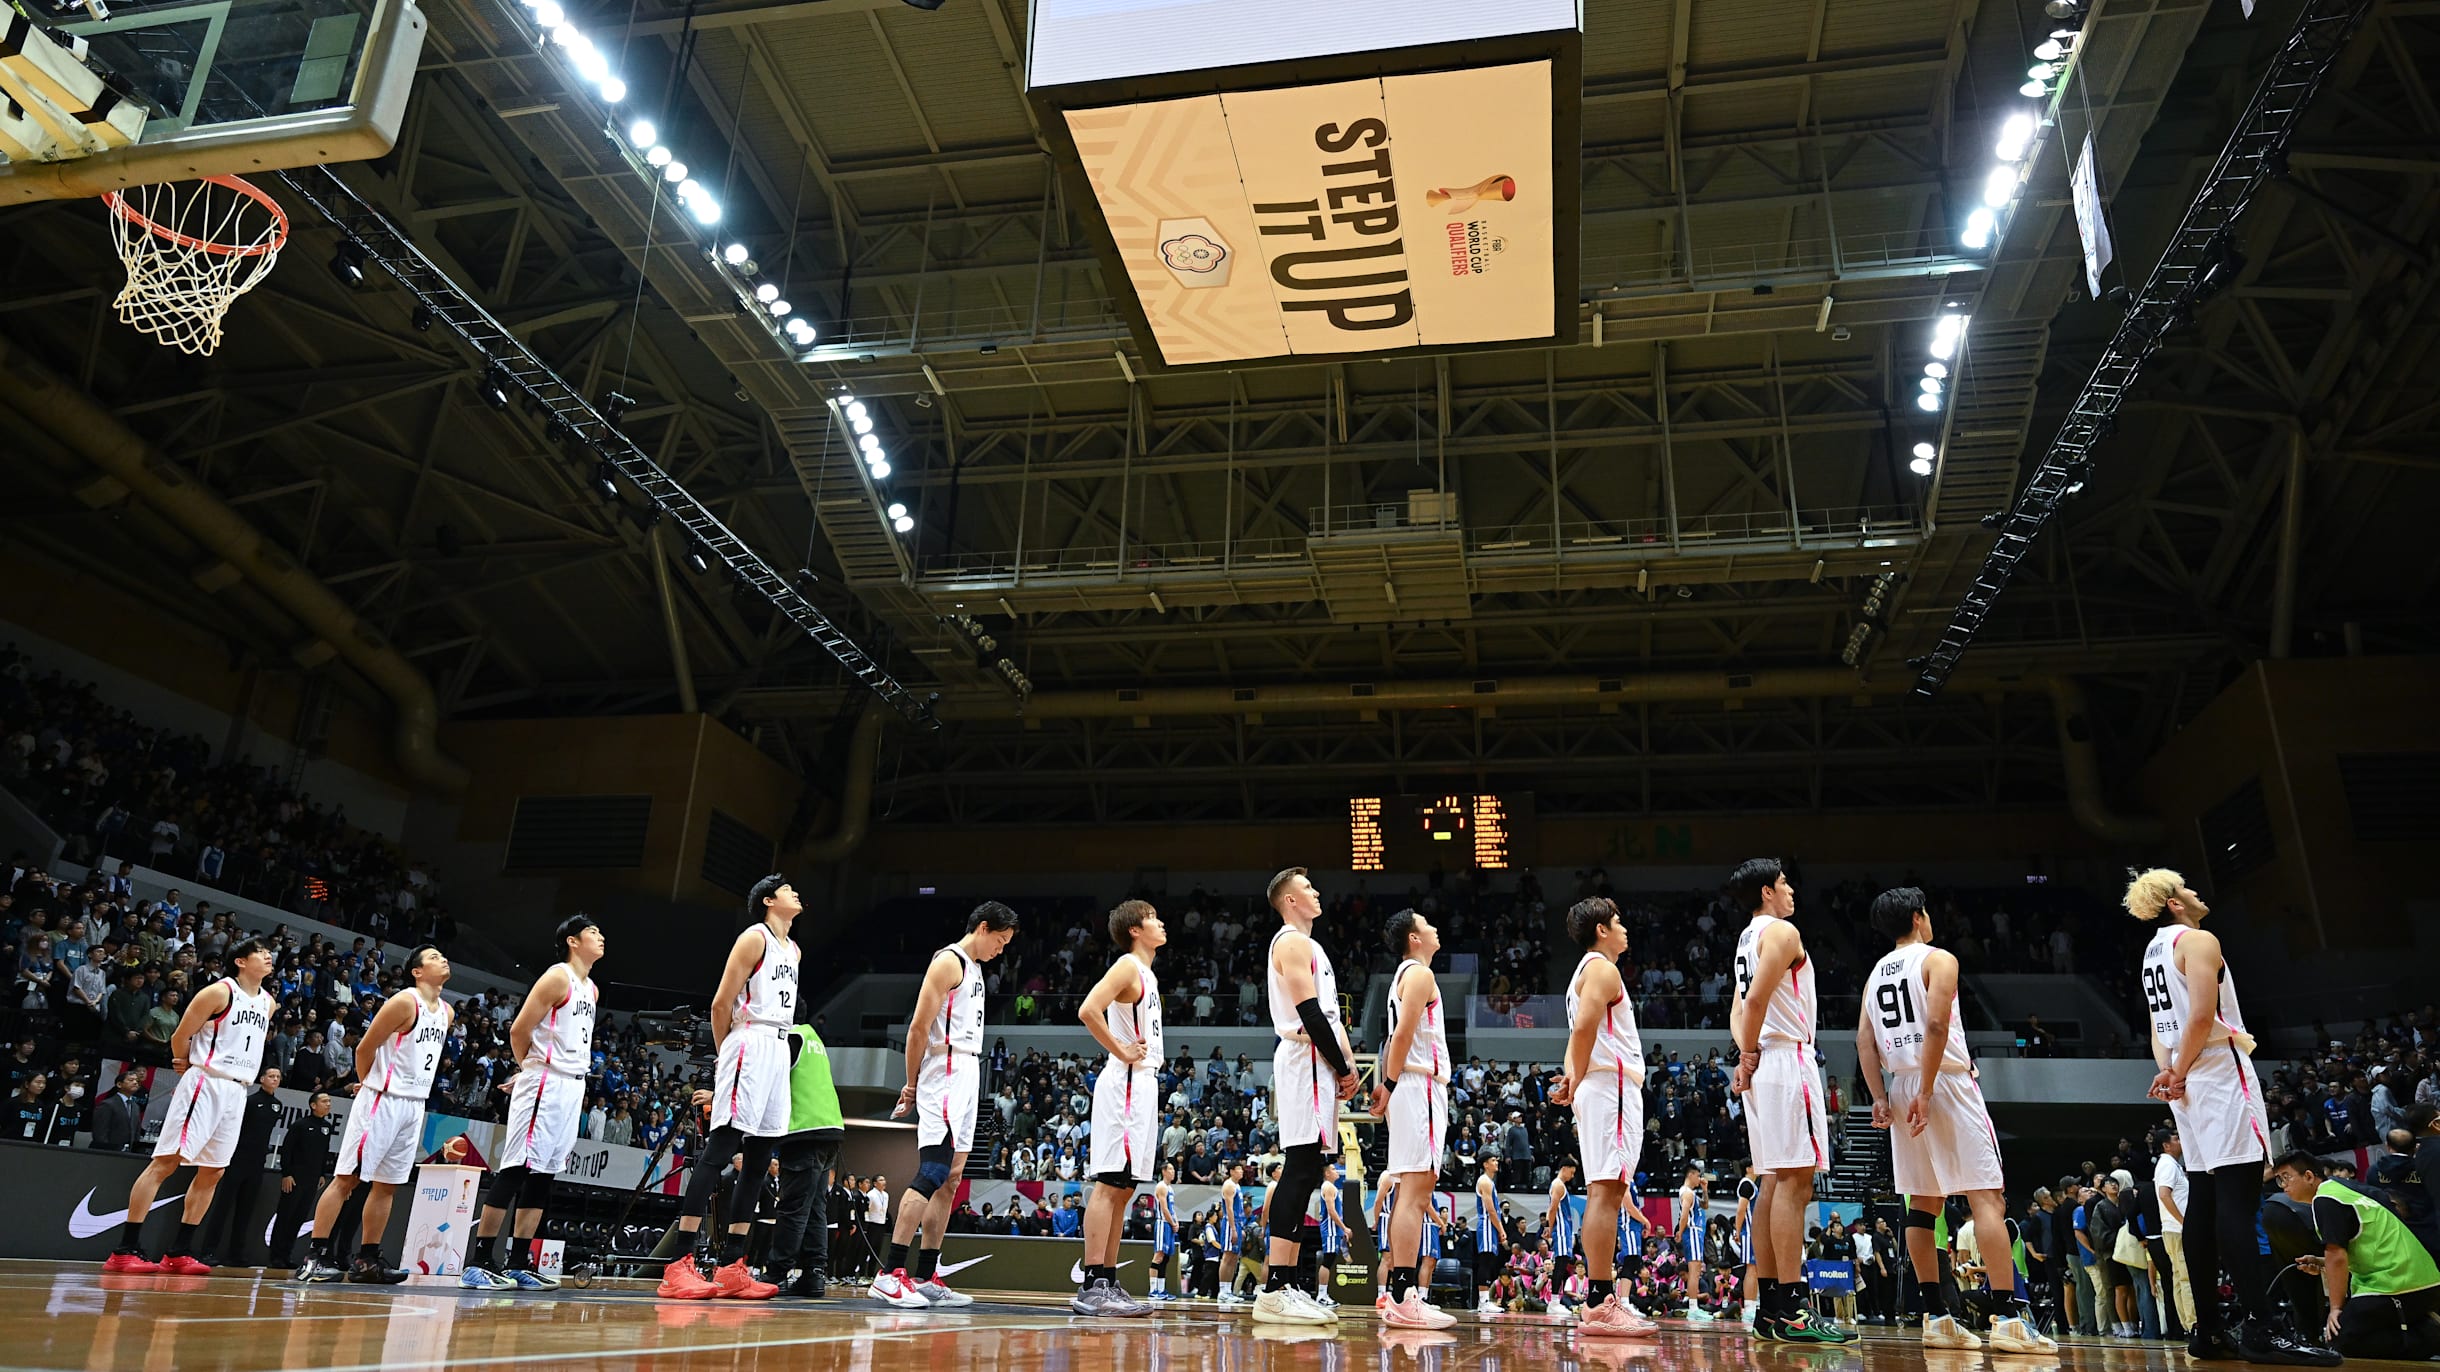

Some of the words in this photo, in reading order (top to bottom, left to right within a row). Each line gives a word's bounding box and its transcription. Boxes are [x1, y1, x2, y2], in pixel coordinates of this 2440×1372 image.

[1315, 117, 1399, 235] STEP
[1253, 198, 1326, 241] IT
[1446, 222, 1469, 276] QUALIFIERS
[1467, 220, 1481, 255] WORLD
[1481, 220, 1491, 272] BASKETBALL
[1470, 256, 1483, 274] CUP
[1270, 237, 1413, 331] UP
[778, 991, 791, 1008] 12
[1877, 978, 1915, 1029] 91
[232, 1010, 267, 1033] JAPAN
[245, 1035, 251, 1052] 1
[582, 1027, 588, 1044] 3
[424, 1053, 434, 1071] 2
[581, 1155, 590, 1176] IT
[590, 1150, 608, 1178] UP
[434, 1188, 448, 1201] UP
[1819, 1270, 1849, 1279] molten
